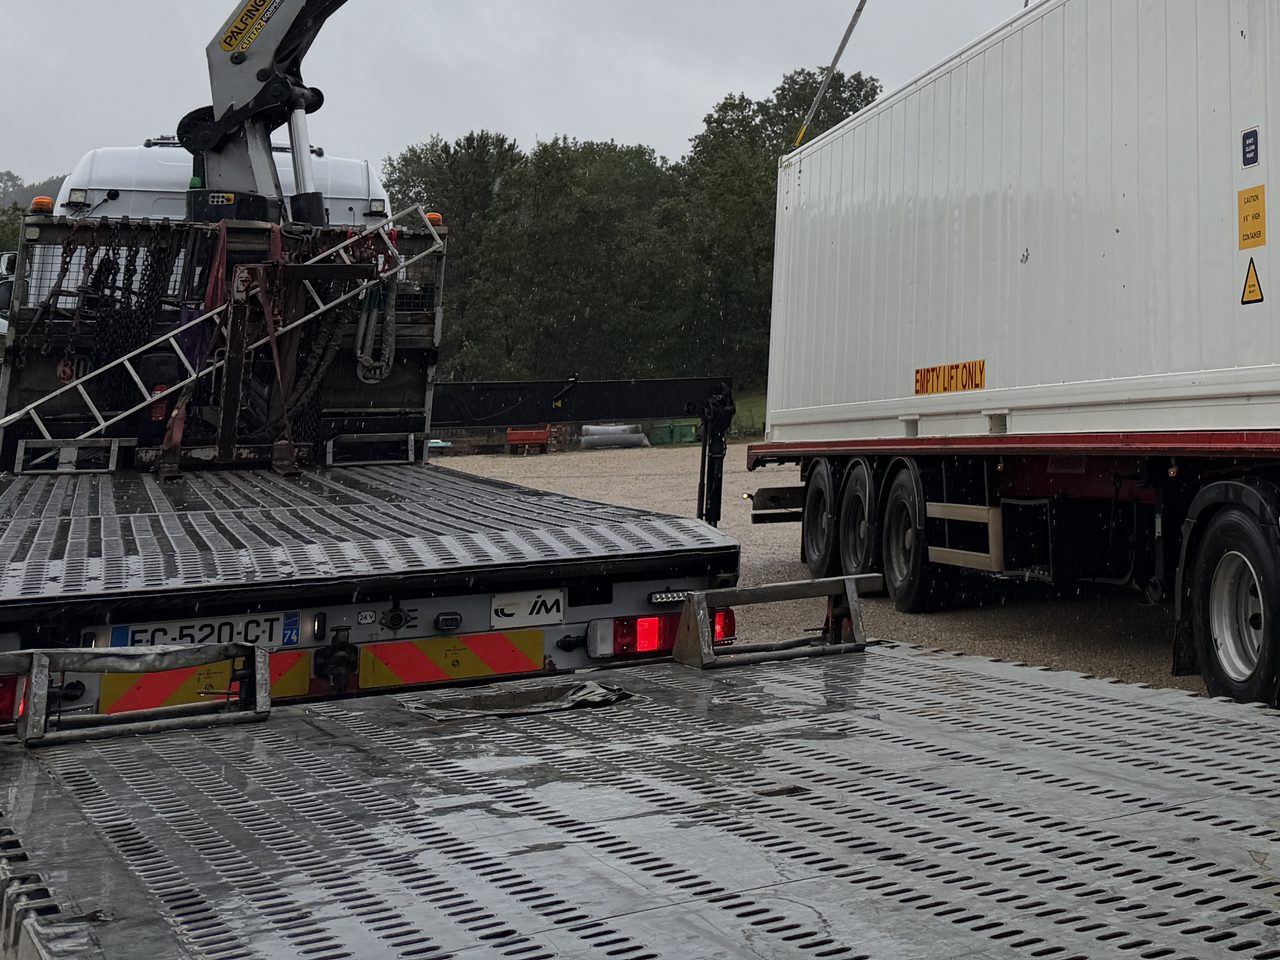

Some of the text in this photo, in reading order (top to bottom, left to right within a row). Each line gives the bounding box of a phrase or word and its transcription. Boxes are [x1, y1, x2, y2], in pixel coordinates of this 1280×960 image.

[241, 22, 265, 50] CUTTAZ
[1244, 194, 1259, 205] CAUTION
[1242, 231, 1262, 242] CONTAINER
[915, 361, 985, 394] EMPTY LIFT ONLY
[284, 629, 298, 644] 74
